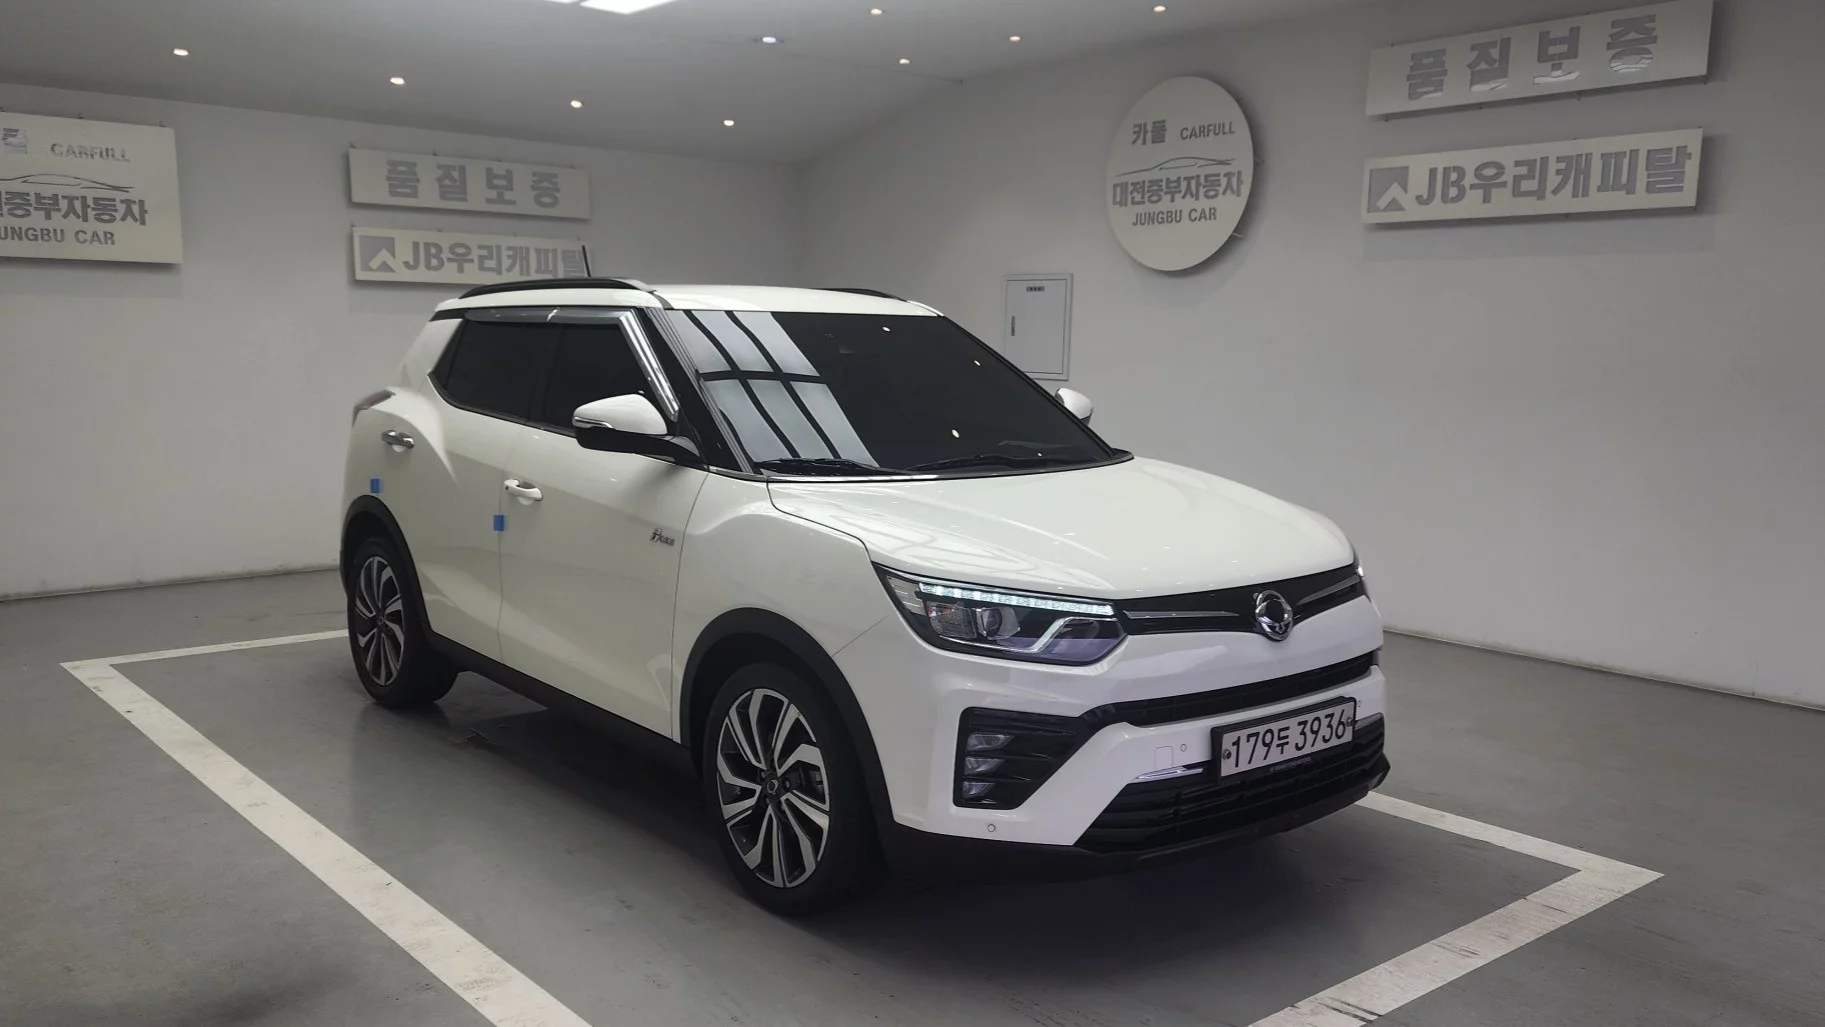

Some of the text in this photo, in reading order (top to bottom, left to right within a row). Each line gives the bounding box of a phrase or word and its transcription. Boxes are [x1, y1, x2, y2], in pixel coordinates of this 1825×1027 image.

[1131, 119, 1236, 146] 카풀 CARFULL
[1112, 170, 1244, 207] 대전중부자동차
[1415, 145, 1692, 206] JB우리캐피탈
[0, 190, 148, 226] 중부자동차
[1132, 206, 1217, 227] JUNGBU CAR
[0, 226, 116, 246] UNGBU CAR
[402, 240, 588, 278] JB우리캐피탈
